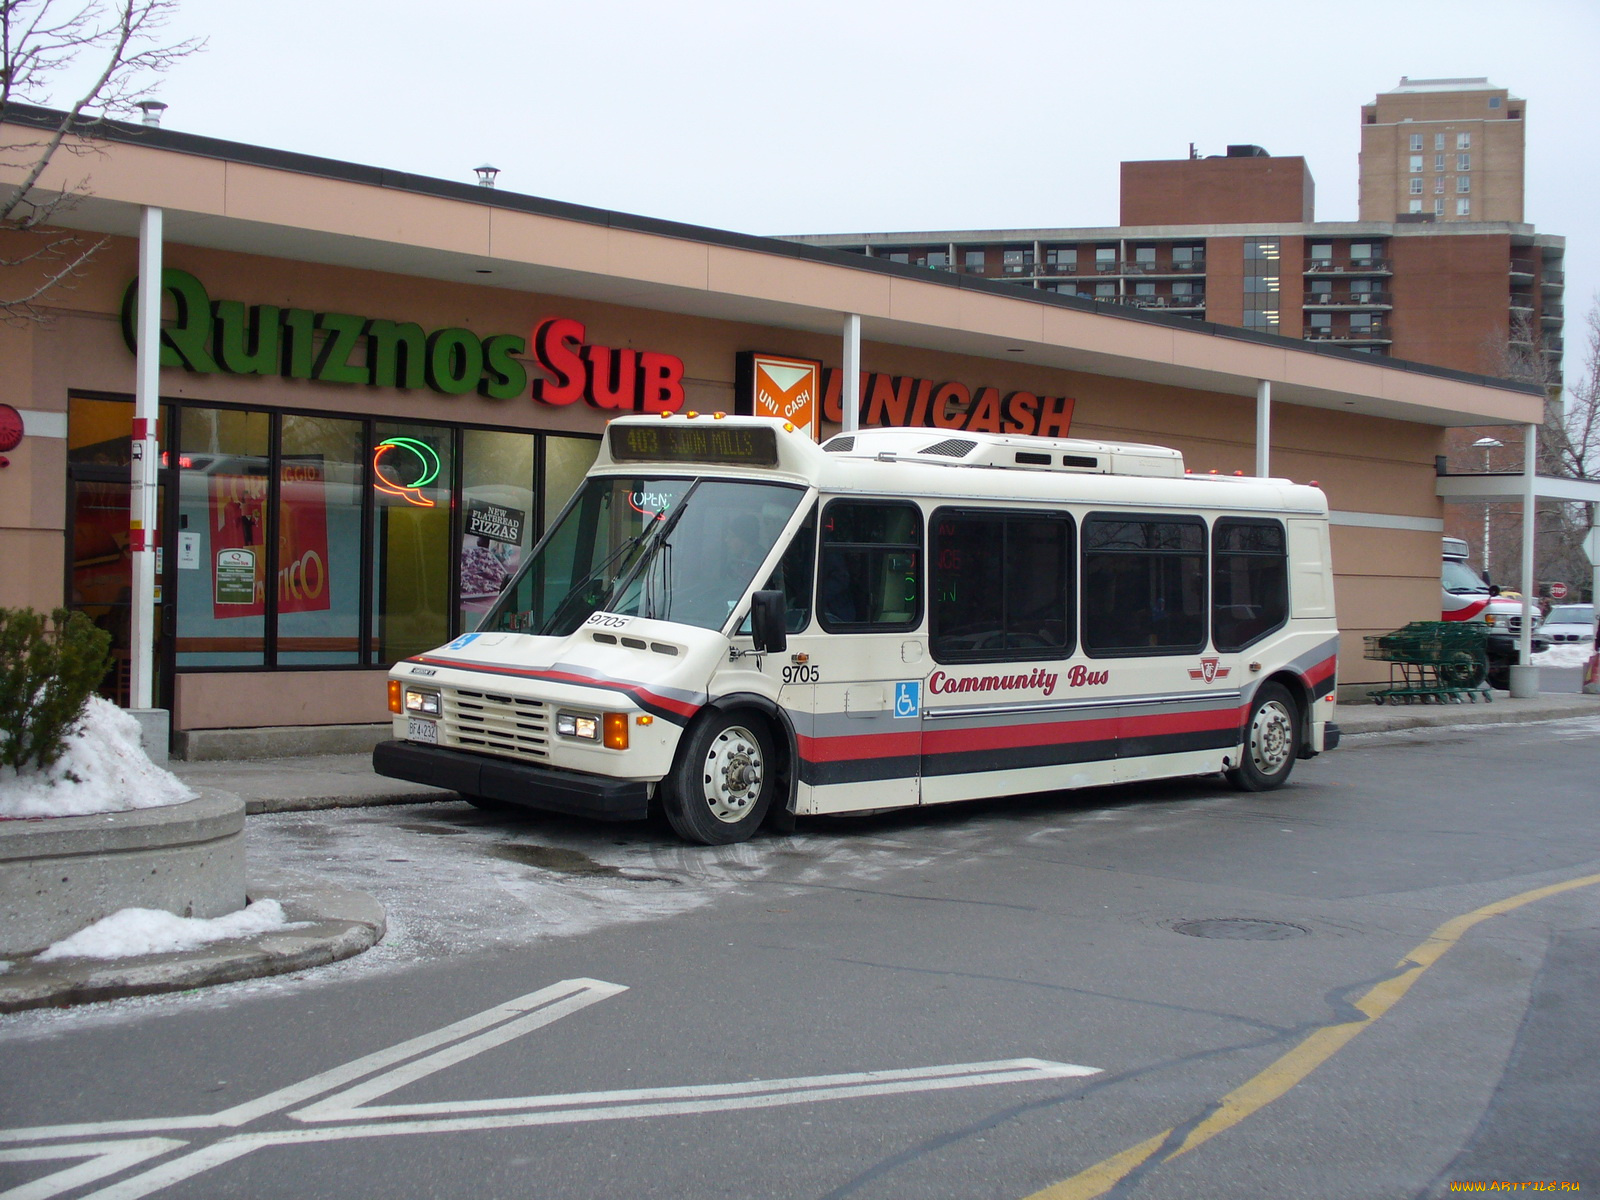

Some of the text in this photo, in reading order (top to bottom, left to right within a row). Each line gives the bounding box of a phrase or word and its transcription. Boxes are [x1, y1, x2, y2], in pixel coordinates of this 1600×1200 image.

[758, 389, 810, 417] UNI CASH
[823, 367, 1076, 439] UNICASH
[627, 429, 659, 453] 403
[711, 431, 754, 456] MILLS
[633, 491, 667, 507] OPEN
[472, 509, 520, 528] FLATBREAD
[488, 506, 507, 518] NEW
[470, 518, 518, 540] PIZZAS
[587, 614, 629, 628] 9705
[782, 664, 819, 684] 9705
[929, 664, 1109, 696] Community Bus
